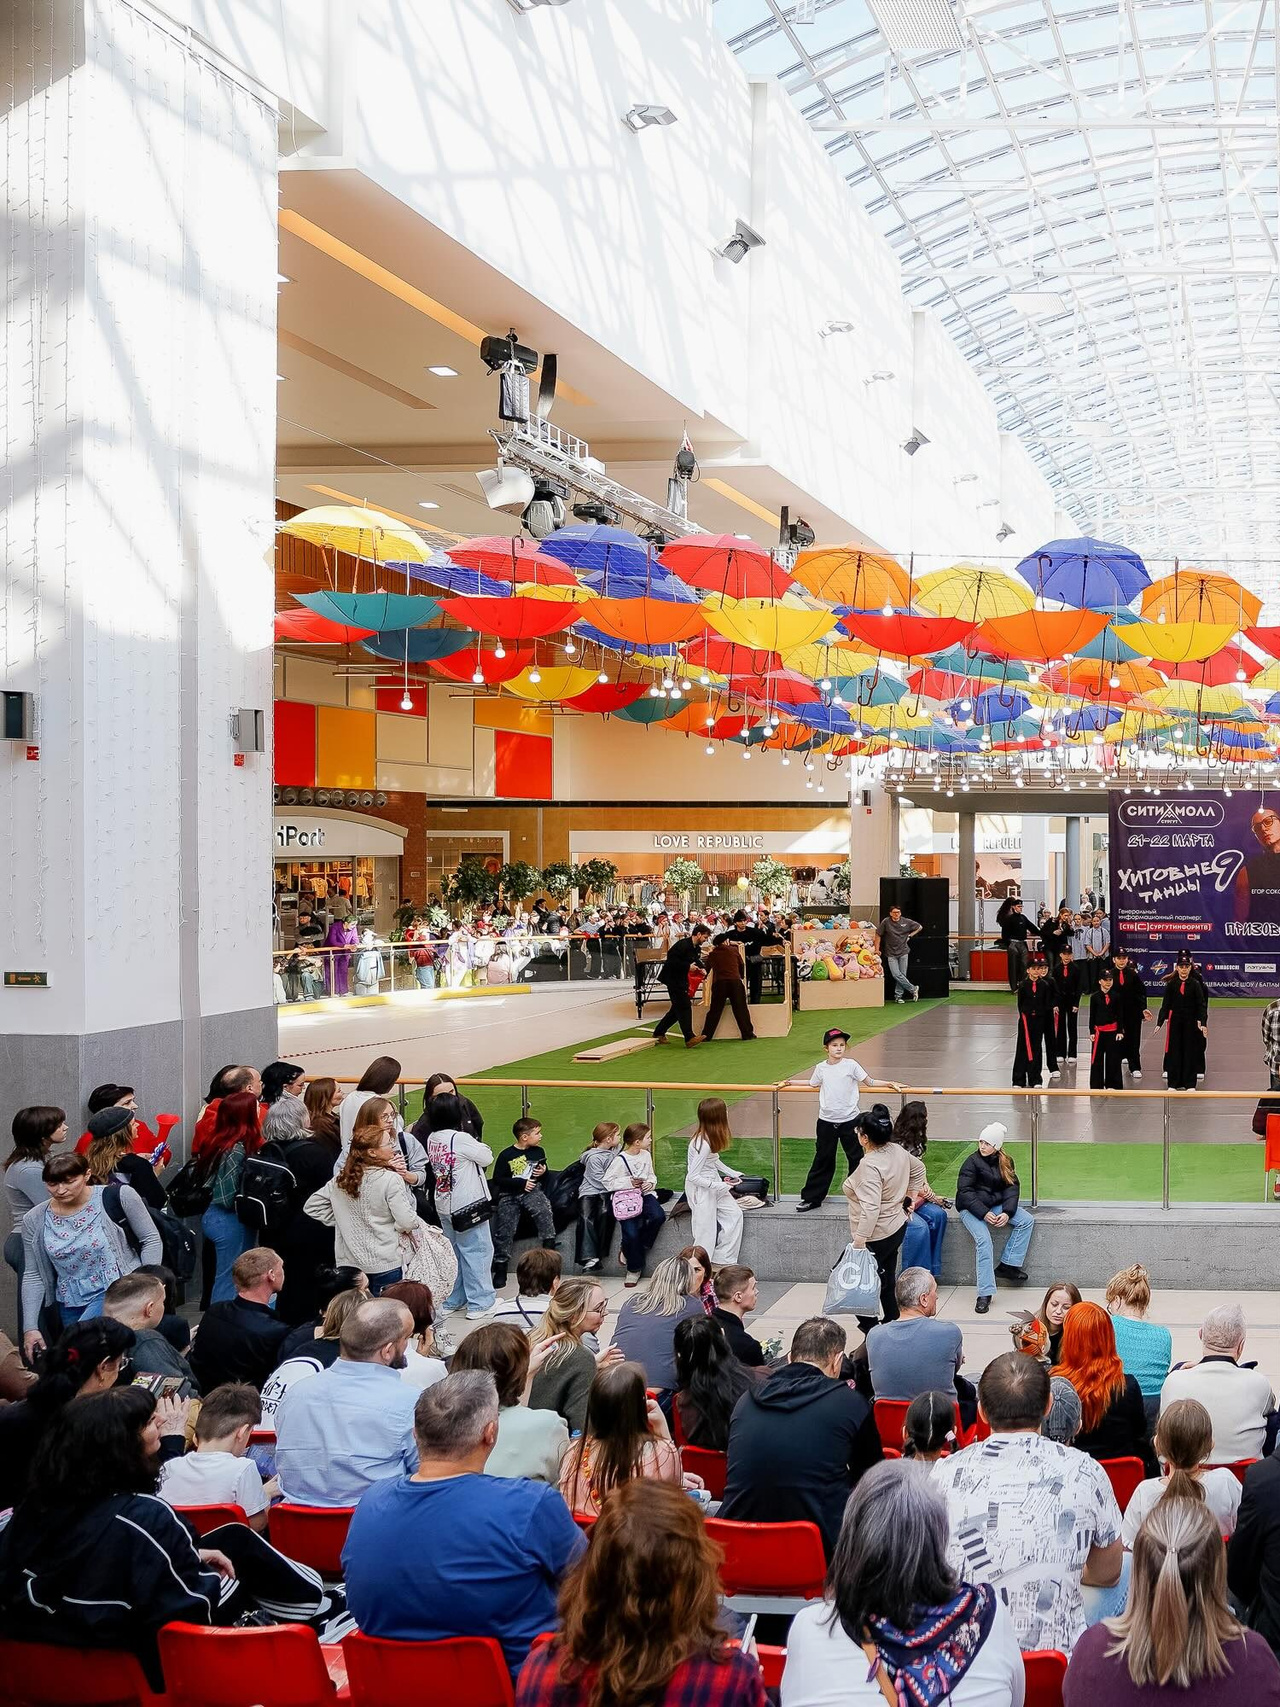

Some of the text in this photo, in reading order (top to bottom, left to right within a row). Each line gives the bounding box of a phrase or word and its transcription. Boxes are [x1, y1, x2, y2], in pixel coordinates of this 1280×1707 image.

[1127, 806, 1215, 816] СИТИ МОЛЛ
[277, 826, 325, 846] iPort
[654, 835, 763, 848] LOVE REPUBLIC
[1127, 834, 1215, 847] 21-22 МАРТА
[983, 837, 1022, 849] REPUBLI
[1117, 861, 1214, 893] ХИТОВЫЕ
[706, 886, 720, 897] LR
[1138, 879, 1200, 904] ТАНЦЫ
[838, 1261, 875, 1290] GJ
